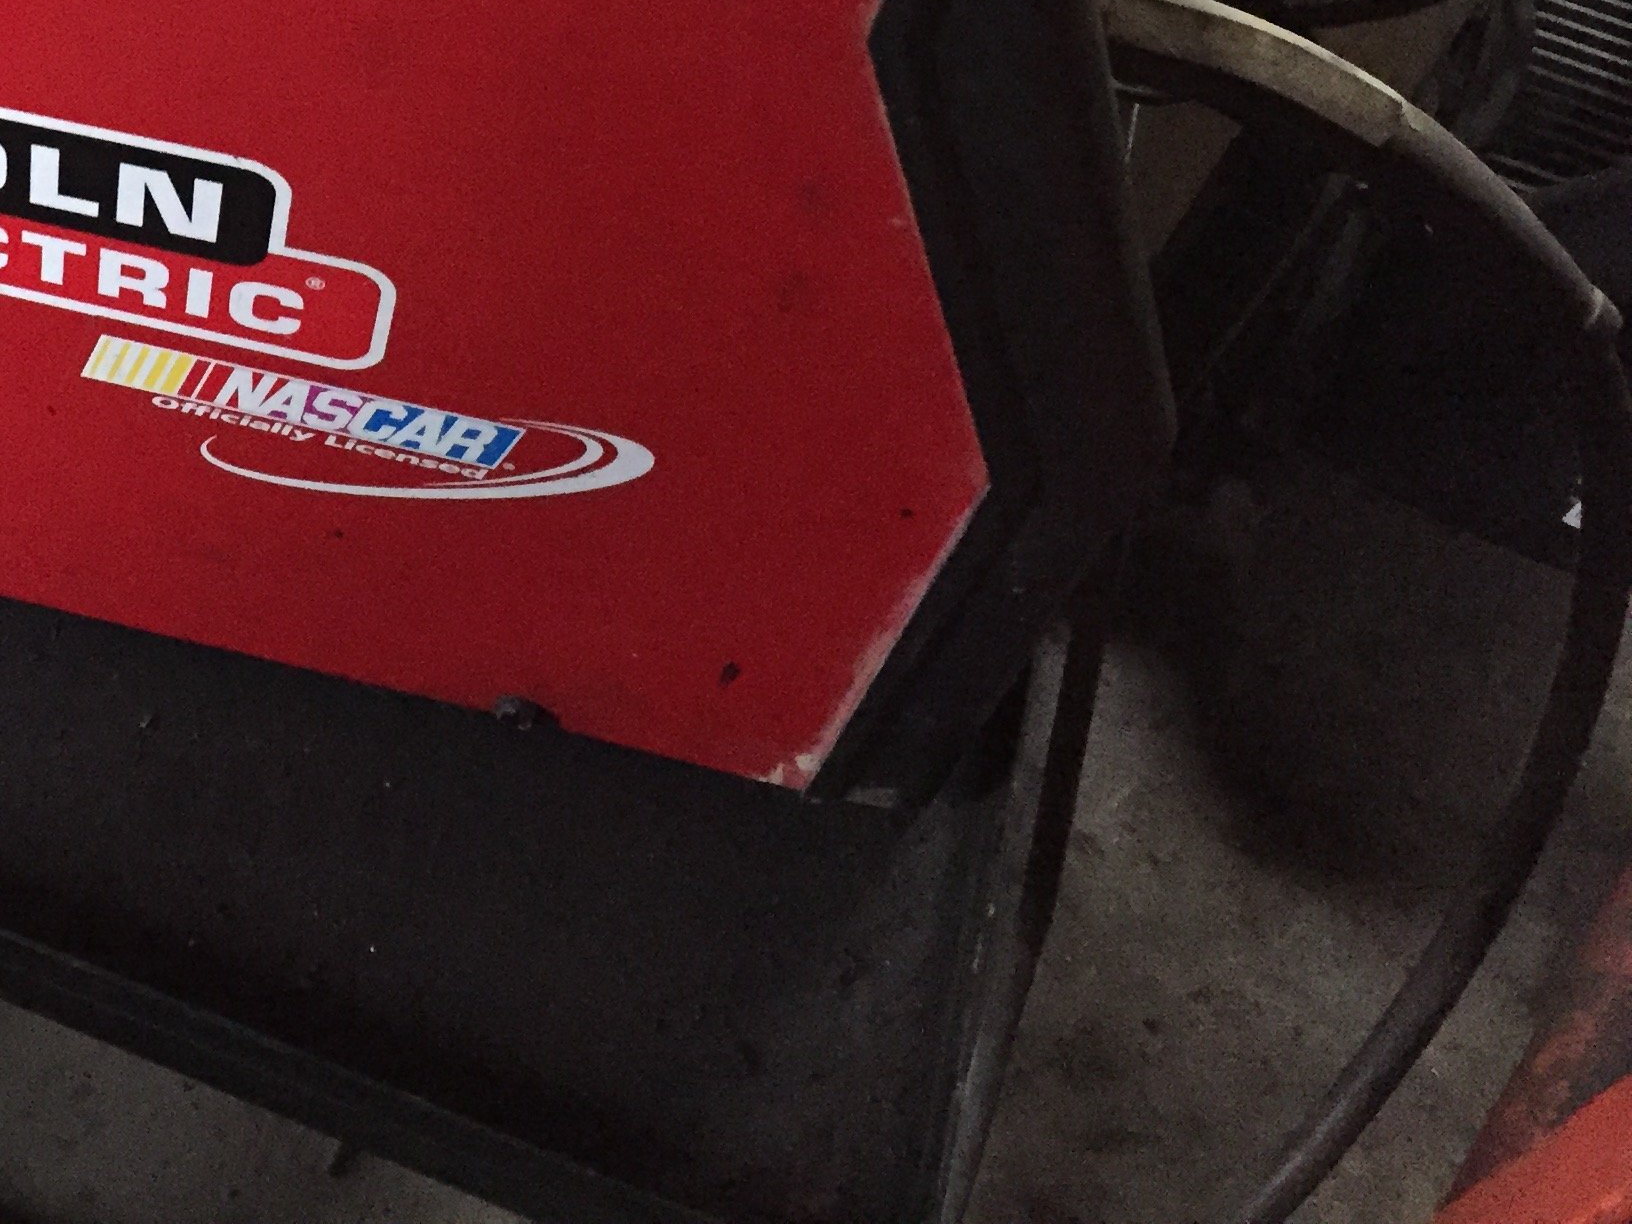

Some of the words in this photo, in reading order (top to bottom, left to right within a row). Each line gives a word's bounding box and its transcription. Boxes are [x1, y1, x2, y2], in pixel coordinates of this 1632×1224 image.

[151, 396, 316, 441] Officially
[325, 435, 488, 480] Licensed
[215, 363, 499, 466] NASCAR
